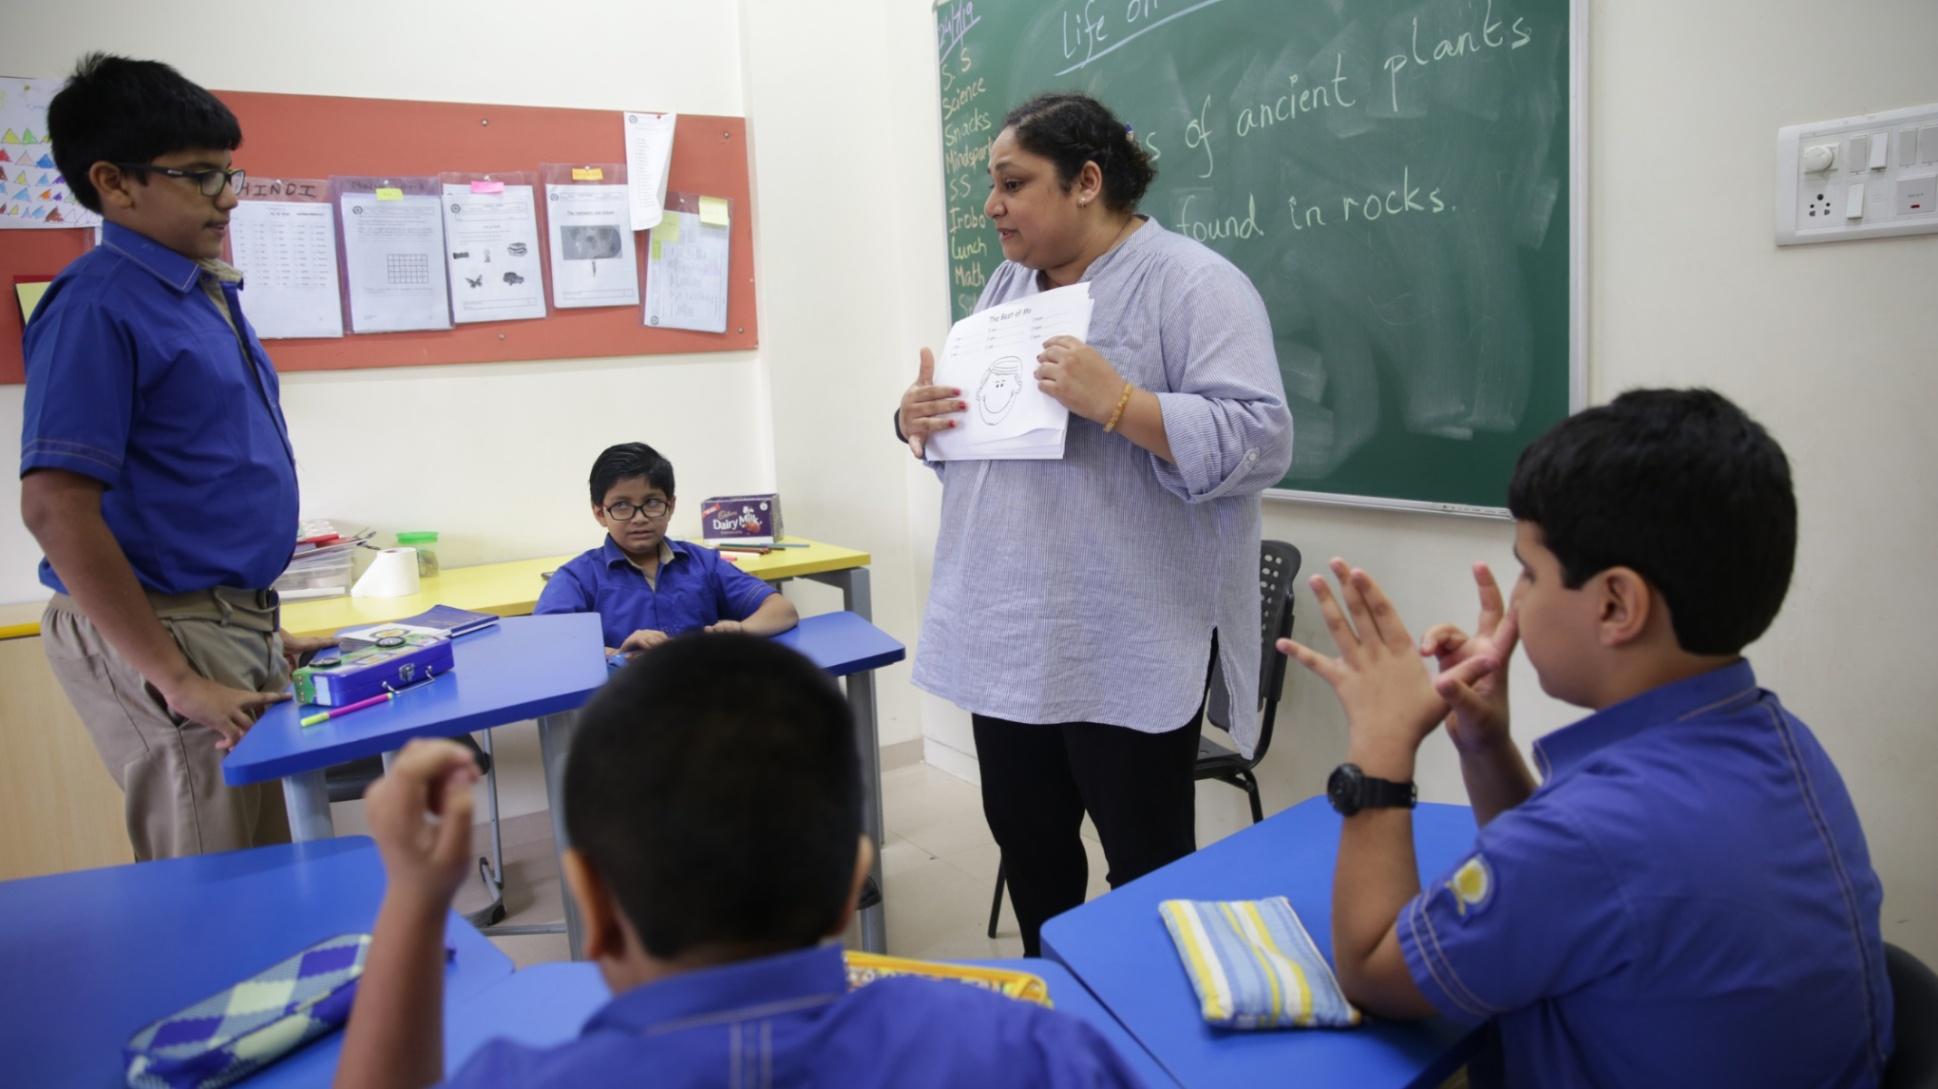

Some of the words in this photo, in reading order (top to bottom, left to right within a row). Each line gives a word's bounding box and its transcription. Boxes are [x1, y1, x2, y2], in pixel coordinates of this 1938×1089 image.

[1063, 0, 1108, 68] Life
[942, 77, 986, 120] Science
[1185, 94, 1214, 178] of
[1236, 54, 1357, 137] ancient
[1384, 0, 1531, 112] plants
[944, 108, 992, 146] Snacks
[1176, 194, 1264, 241] found
[1288, 196, 1326, 230] in
[1343, 166, 1457, 221] rocks.
[951, 236, 987, 260] Lunch
[955, 261, 985, 287] Math
[713, 518, 738, 531] Dairy
[739, 513, 760, 526] Milk
